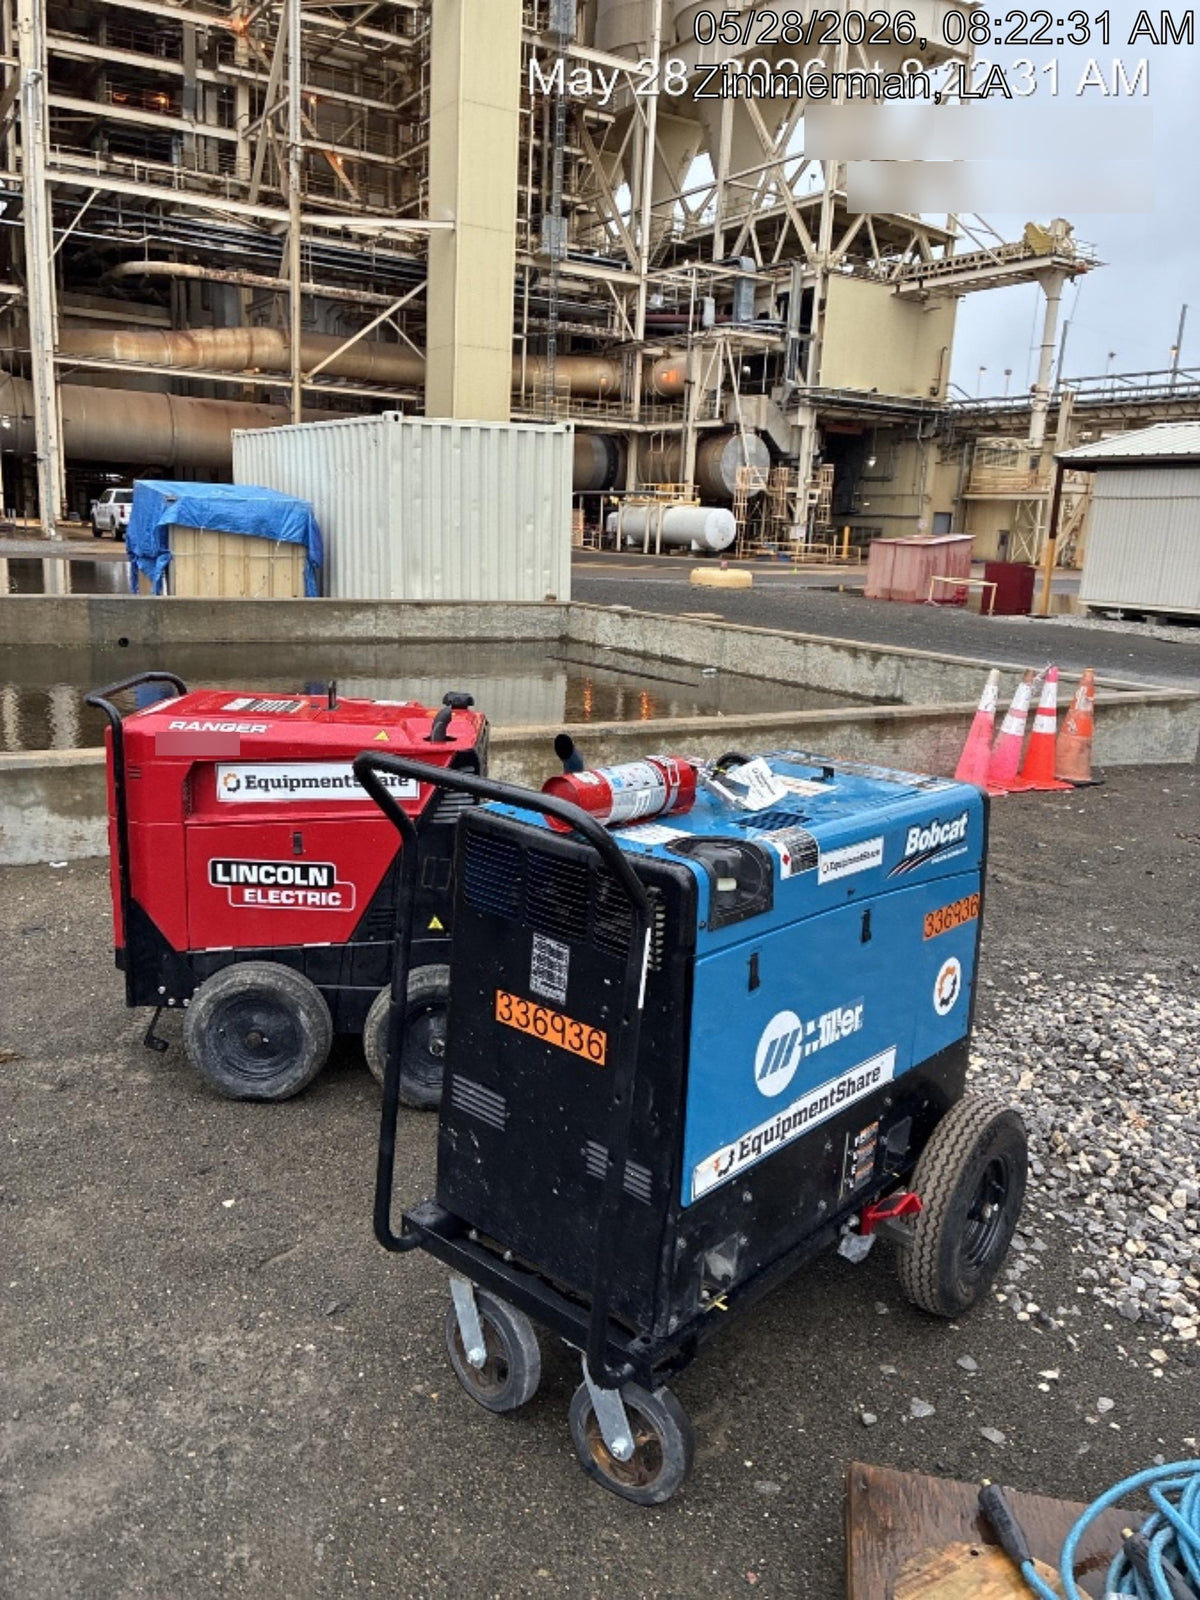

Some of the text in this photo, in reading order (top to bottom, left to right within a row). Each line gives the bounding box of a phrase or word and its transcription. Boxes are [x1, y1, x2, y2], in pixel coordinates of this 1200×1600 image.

[168, 721, 268, 734] RANGER
[905, 810, 968, 856] Bobcat
[215, 863, 329, 887] LINCOLN
[243, 888, 342, 906] ELECTRIC
[924, 893, 980, 939] 336936
[498, 993, 605, 1060] 336936
[738, 1065, 881, 1162] EquipmentShare
